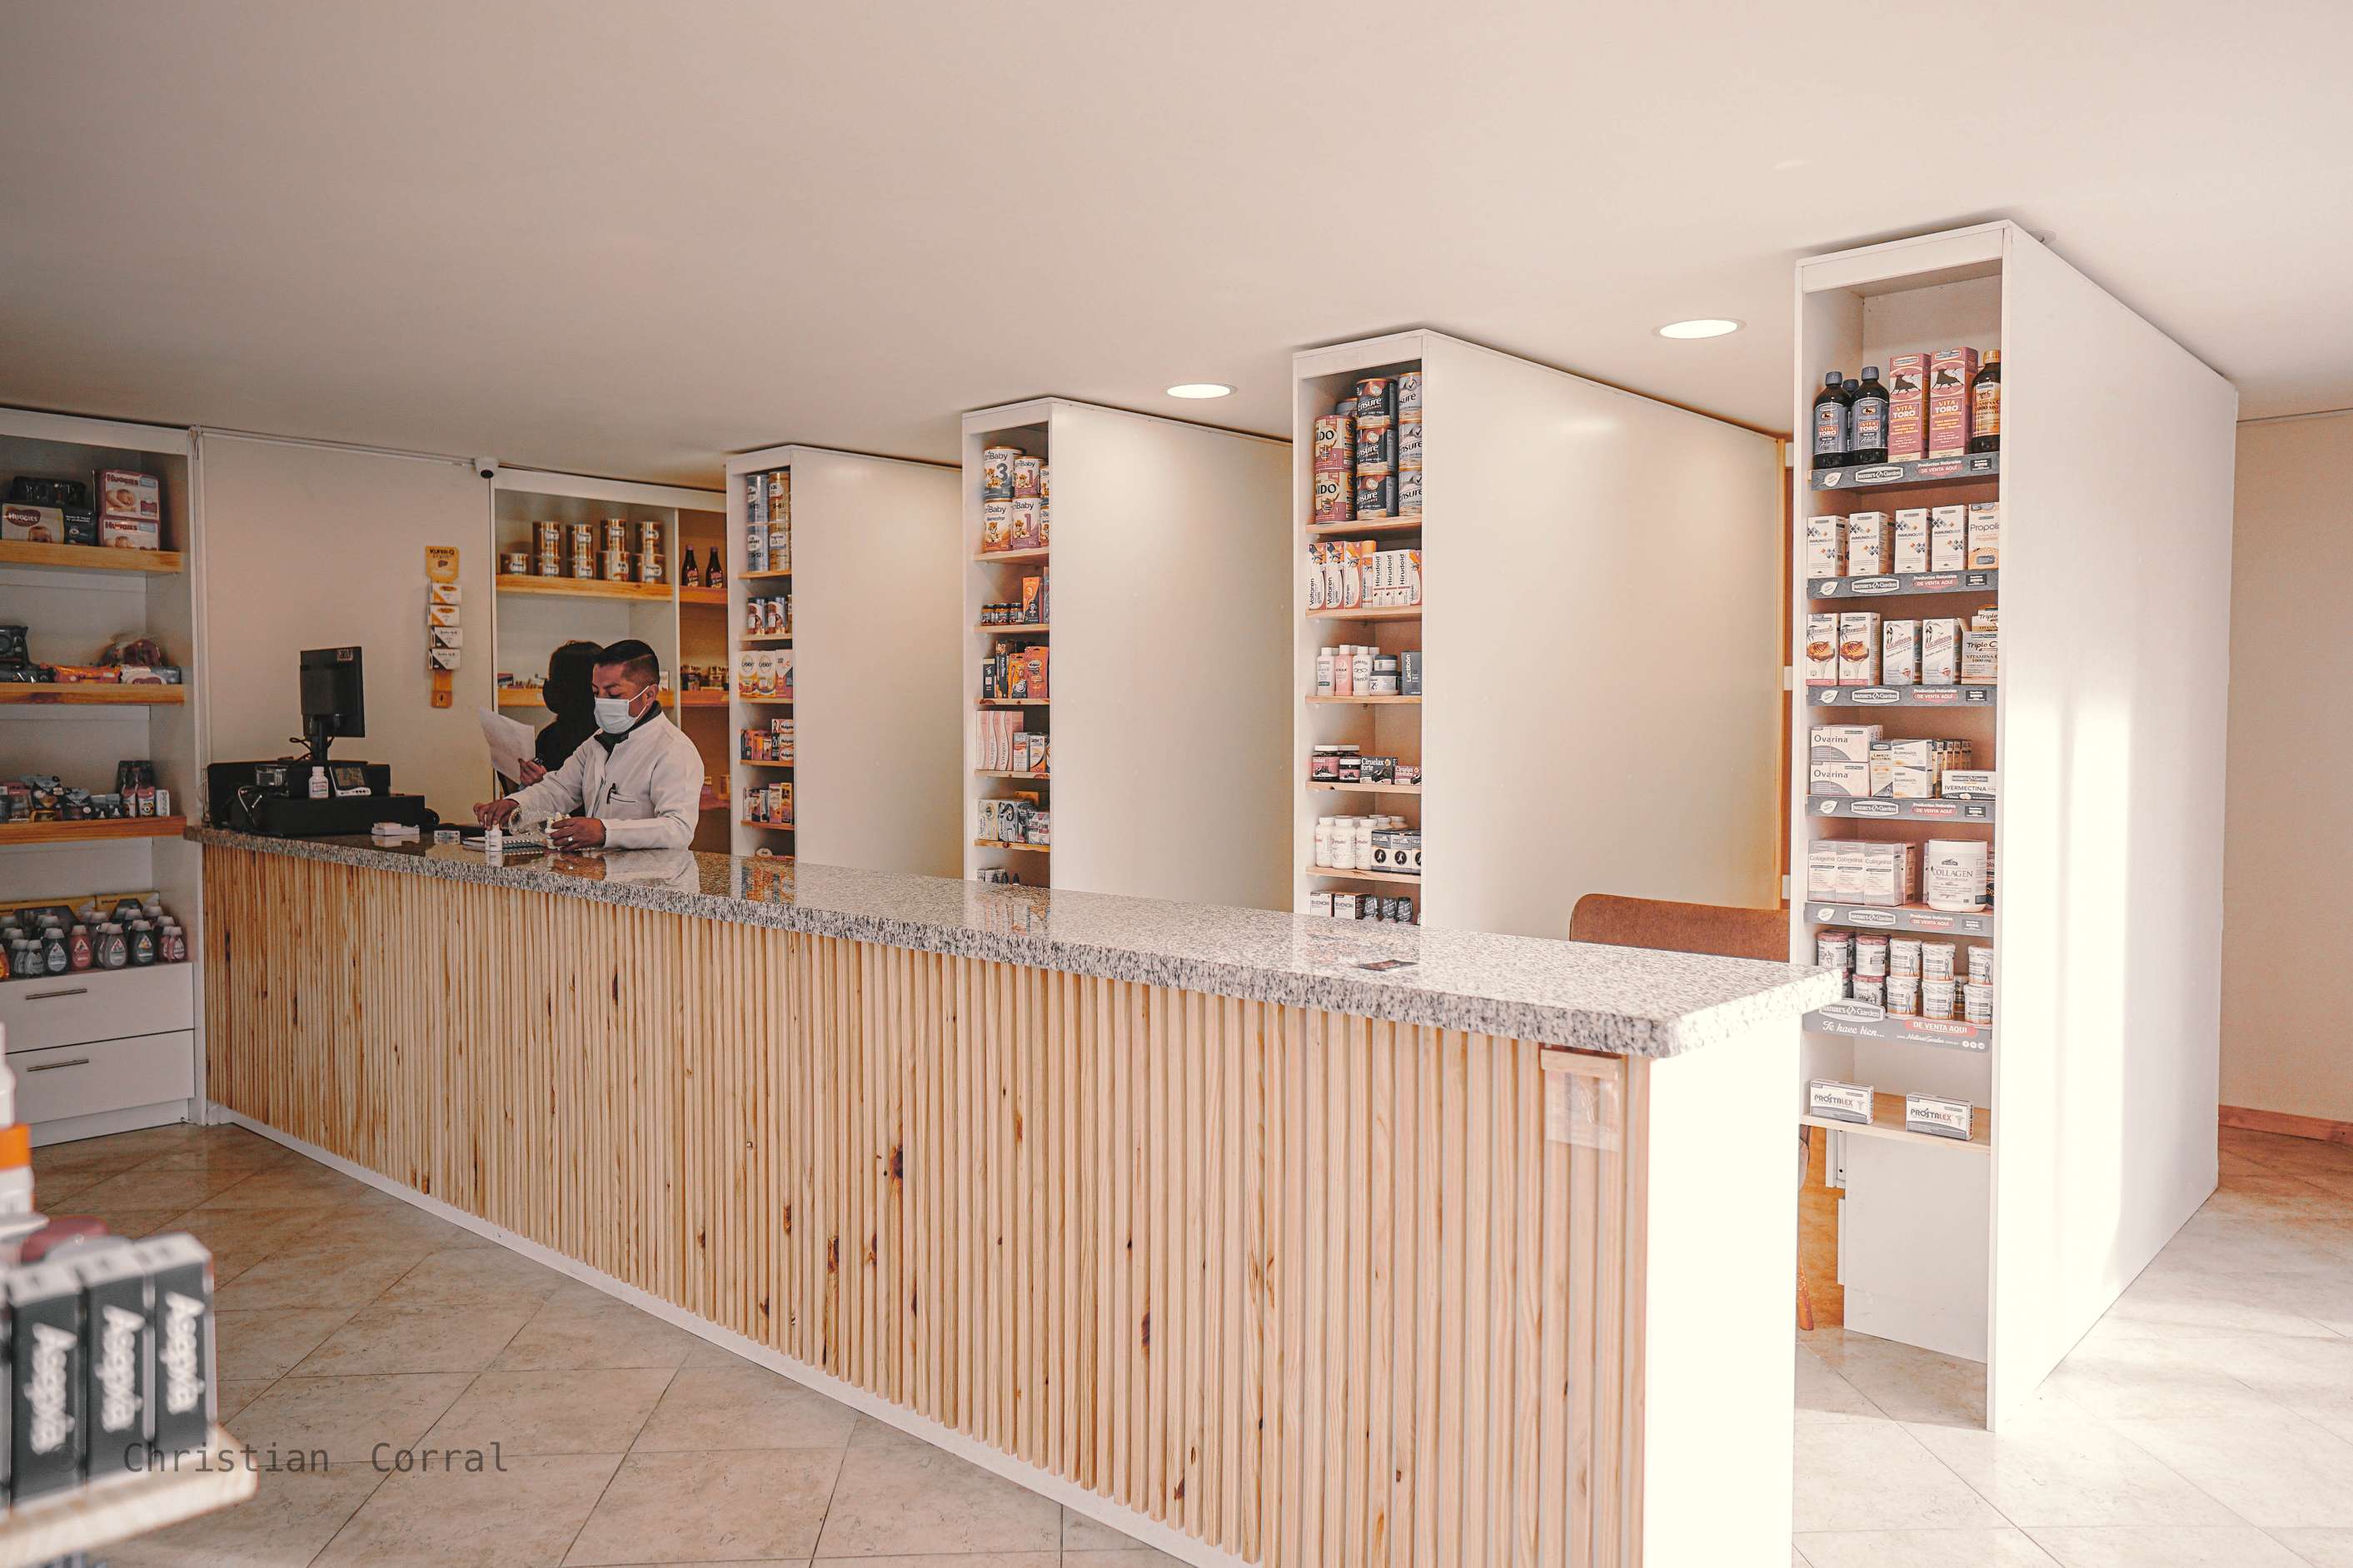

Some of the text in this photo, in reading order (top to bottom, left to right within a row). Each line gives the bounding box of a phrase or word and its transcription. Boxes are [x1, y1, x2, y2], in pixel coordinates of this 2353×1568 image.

[1399, 393, 1417, 406] sure
[1935, 406, 1959, 414] TORO
[1893, 411, 1916, 419] TORO
[1316, 430, 1334, 441] IDO
[997, 463, 1008, 480] 3
[8, 512, 38, 522] HUGGIES
[1967, 642, 1987, 650] Triple
[1814, 734, 1848, 743] Ovarina
[1814, 769, 1848, 778] Ovarina
[1932, 869, 1973, 878] COLLAGEN
[1857, 1008, 1879, 1017] Garden
[1837, 1023, 1858, 1034] hace
[1925, 1023, 1947, 1031] VENTA
